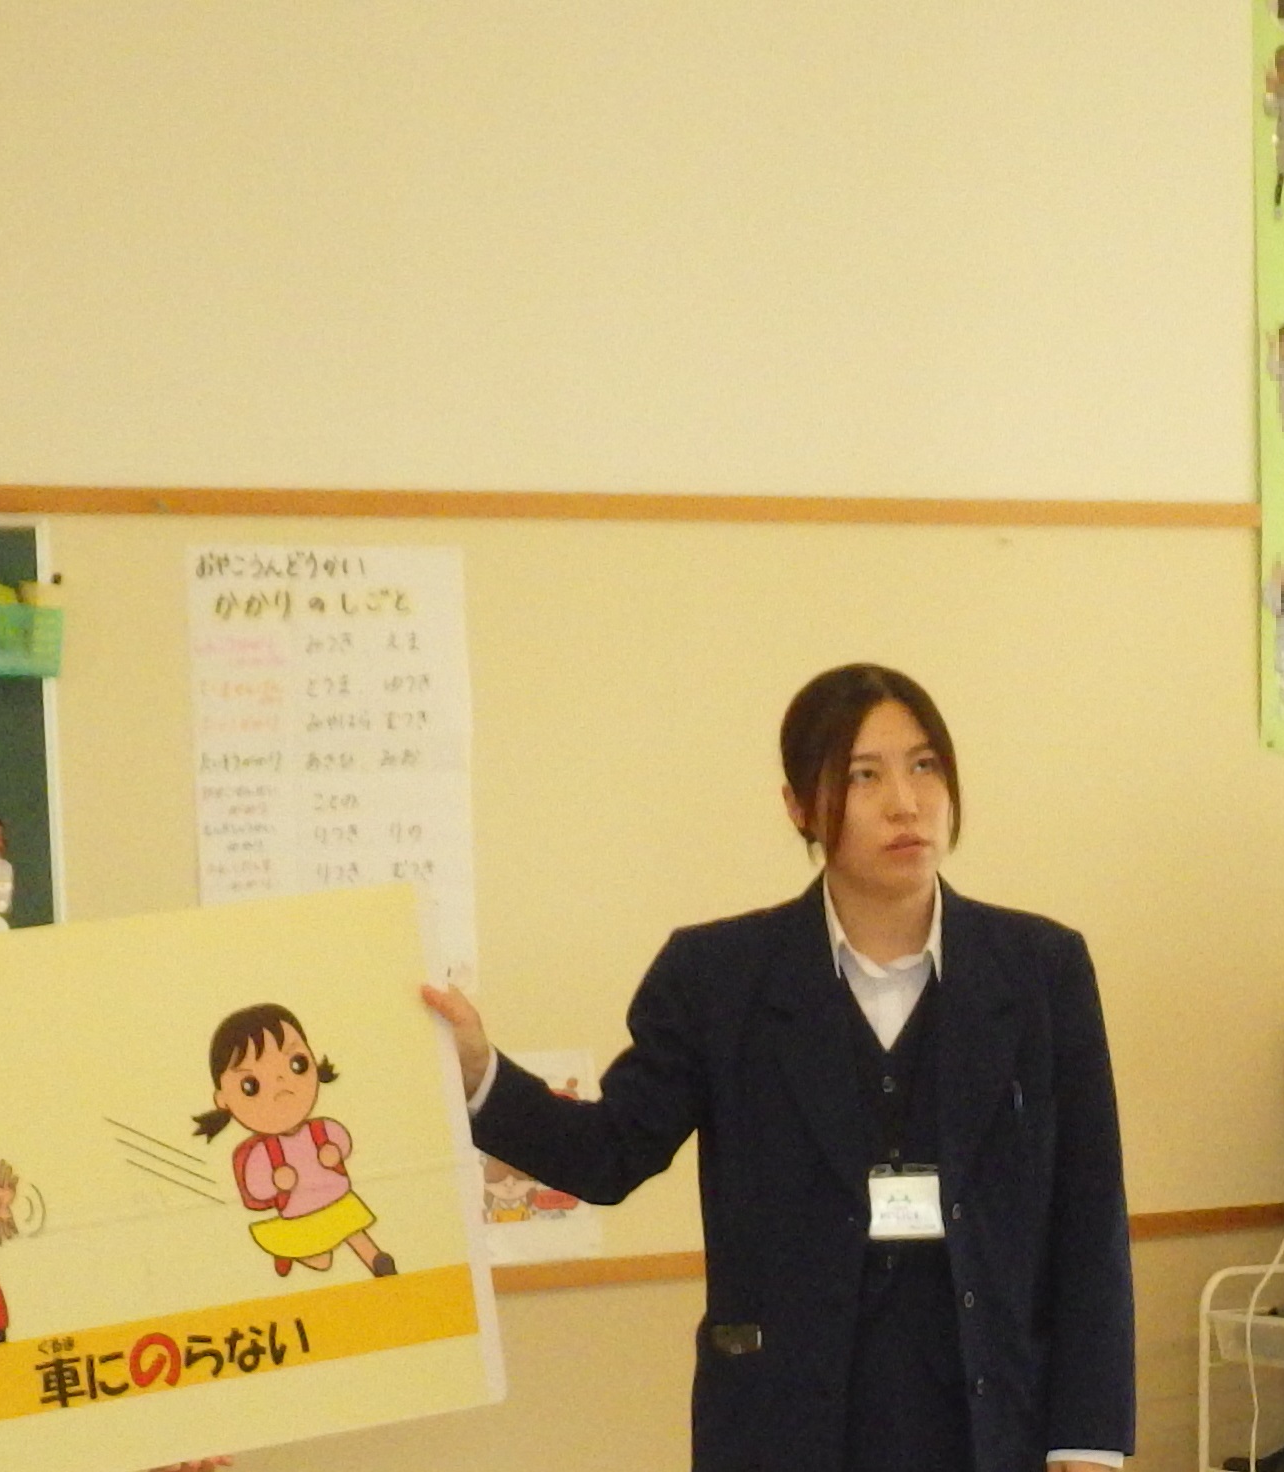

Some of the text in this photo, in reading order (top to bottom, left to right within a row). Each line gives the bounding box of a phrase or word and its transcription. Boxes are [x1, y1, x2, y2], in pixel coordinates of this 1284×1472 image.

[35, 1317, 311, 1408] 車にのらない
